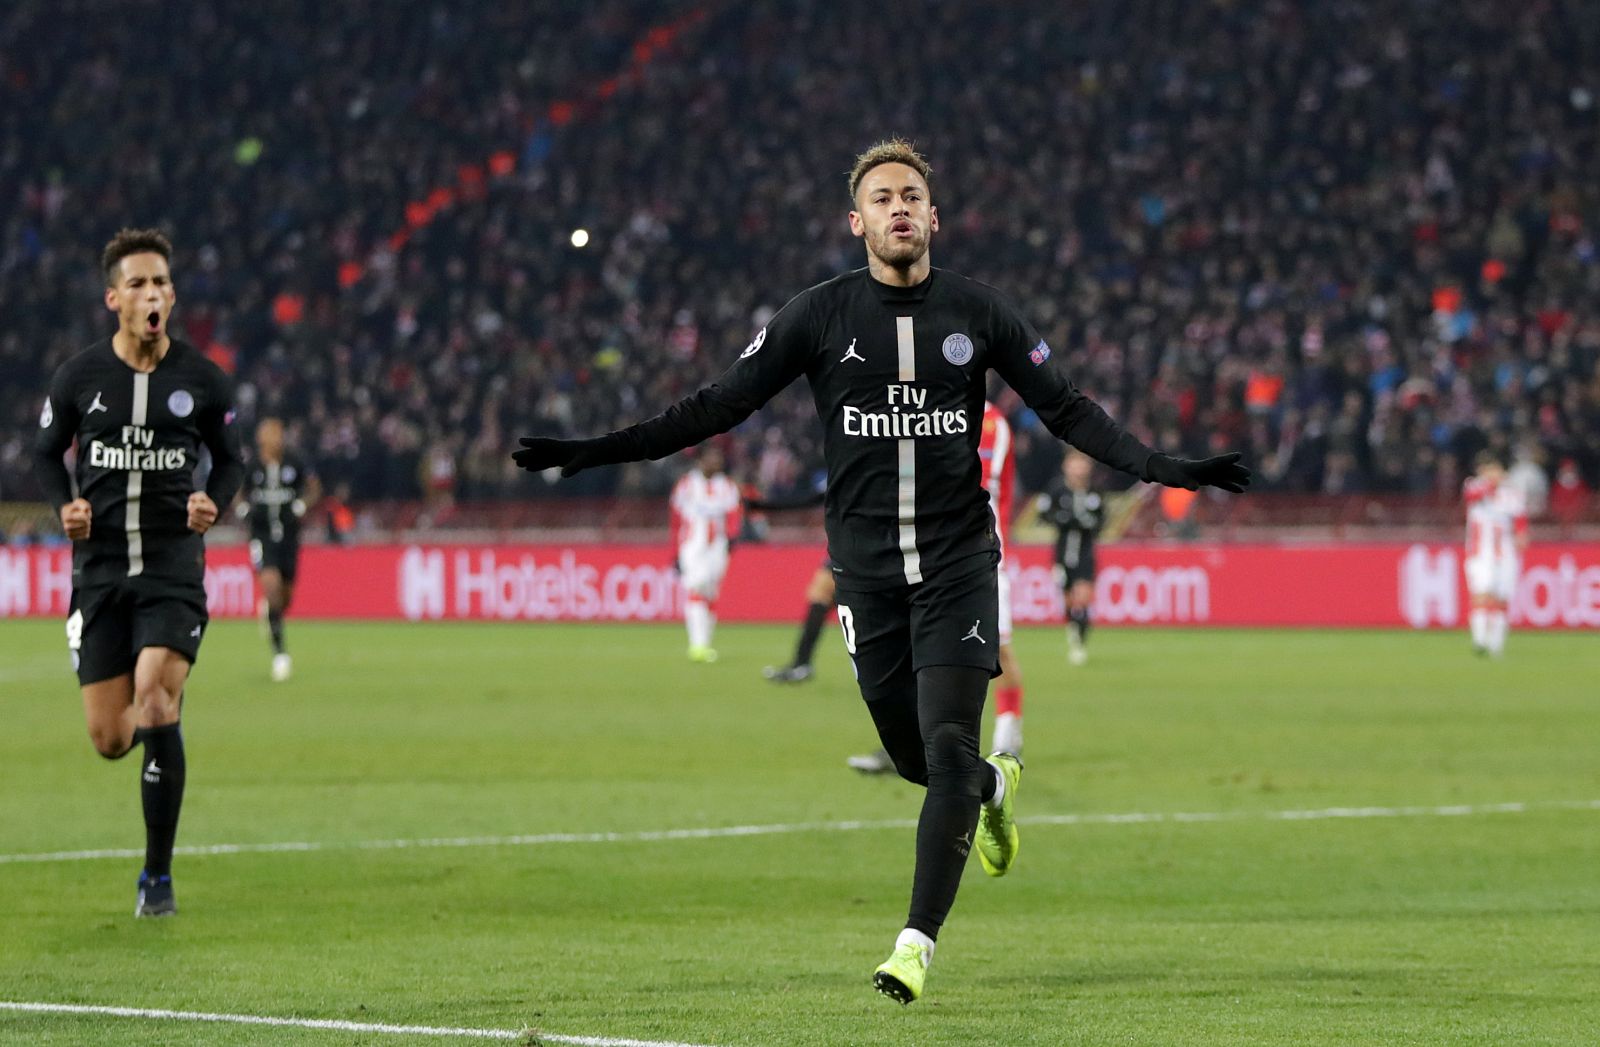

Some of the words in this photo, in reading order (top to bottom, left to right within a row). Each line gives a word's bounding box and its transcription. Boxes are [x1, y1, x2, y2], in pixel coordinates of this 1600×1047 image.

[887, 384, 927, 409] Fly
[843, 405, 968, 437] Emirates
[122, 425, 154, 448] Fly
[90, 440, 186, 470] Emirates
